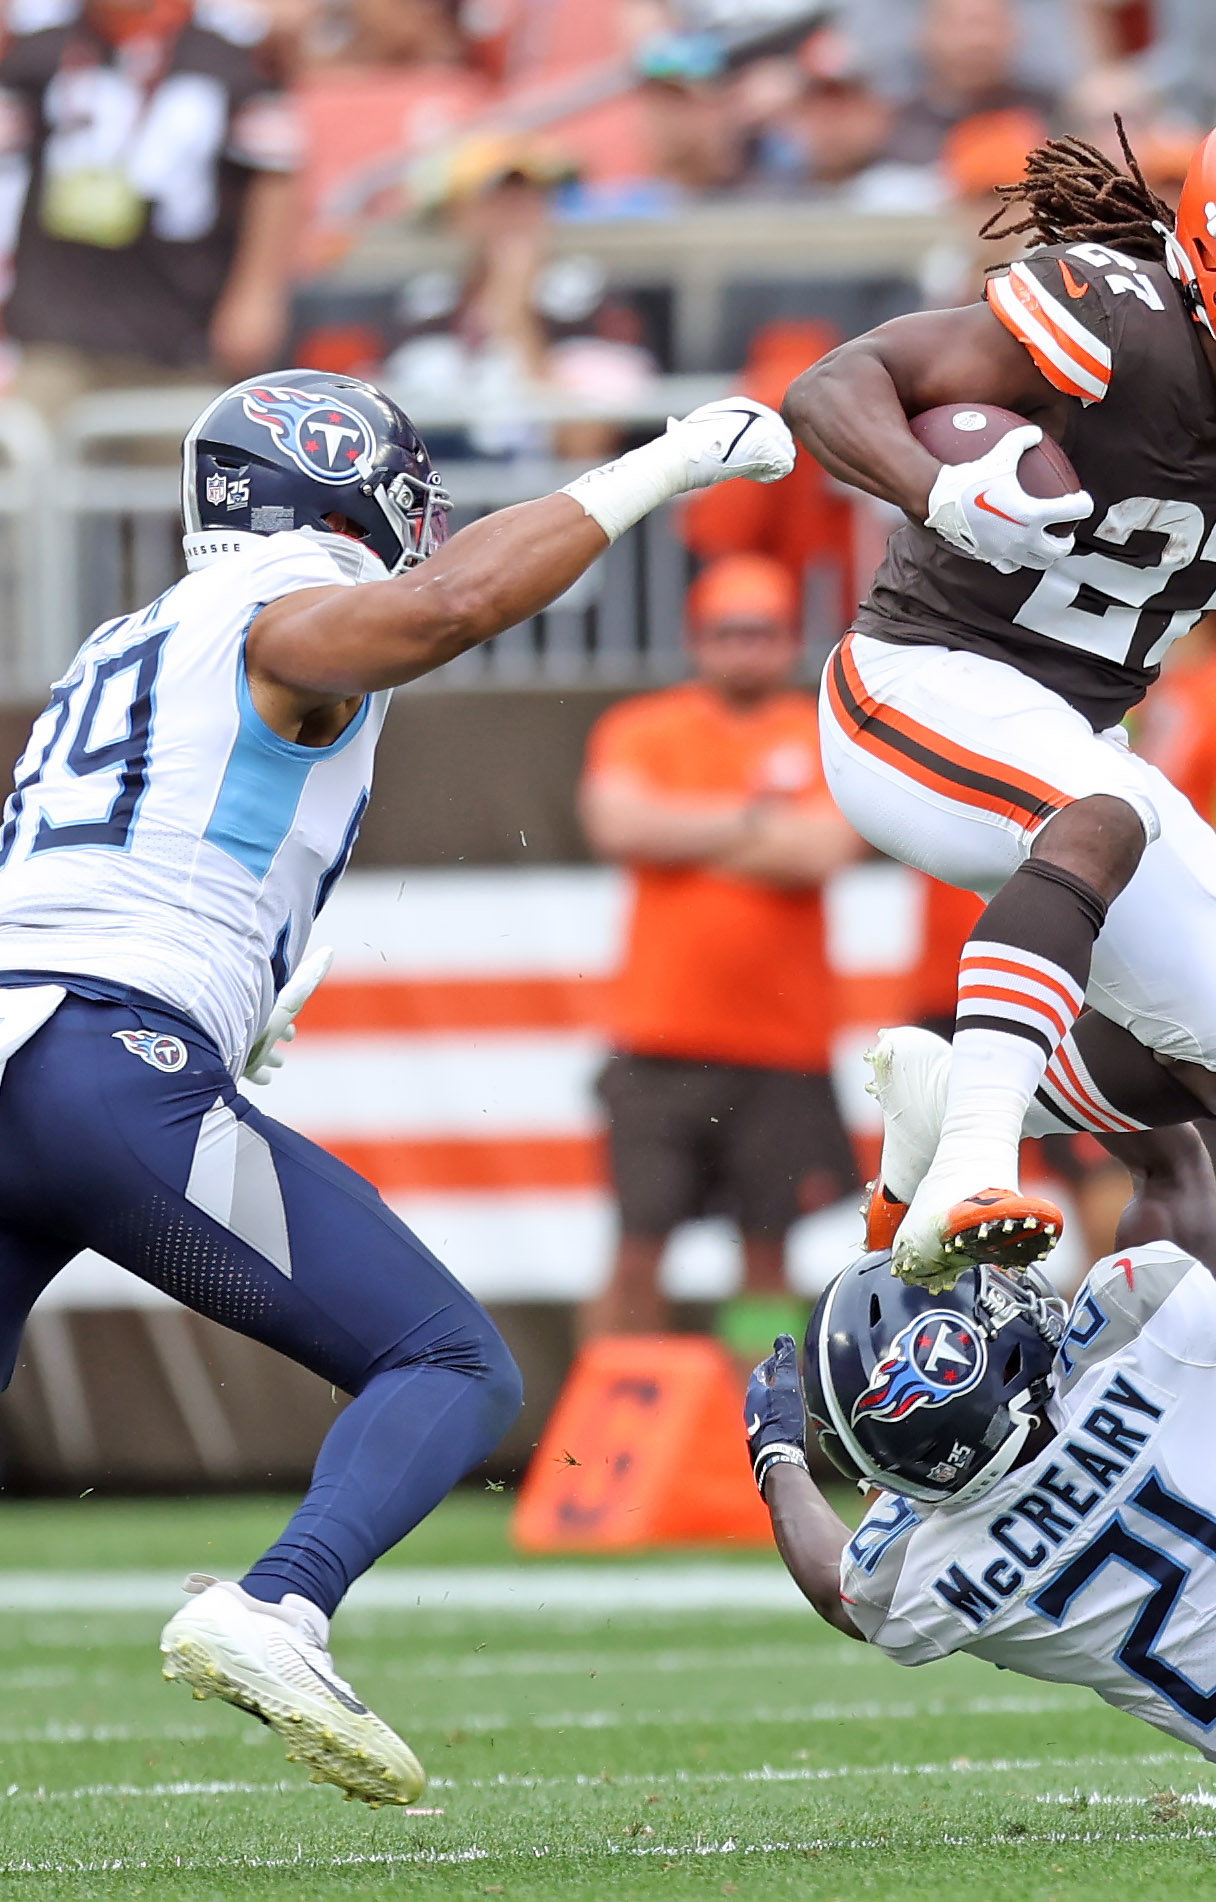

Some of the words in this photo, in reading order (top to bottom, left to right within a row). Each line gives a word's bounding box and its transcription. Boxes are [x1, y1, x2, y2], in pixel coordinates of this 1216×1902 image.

[227, 478, 251, 506] 25
[185, 543, 240, 559] ESSEE
[932, 1371, 1166, 1628] McCREARY
[847, 1496, 921, 1578] 21
